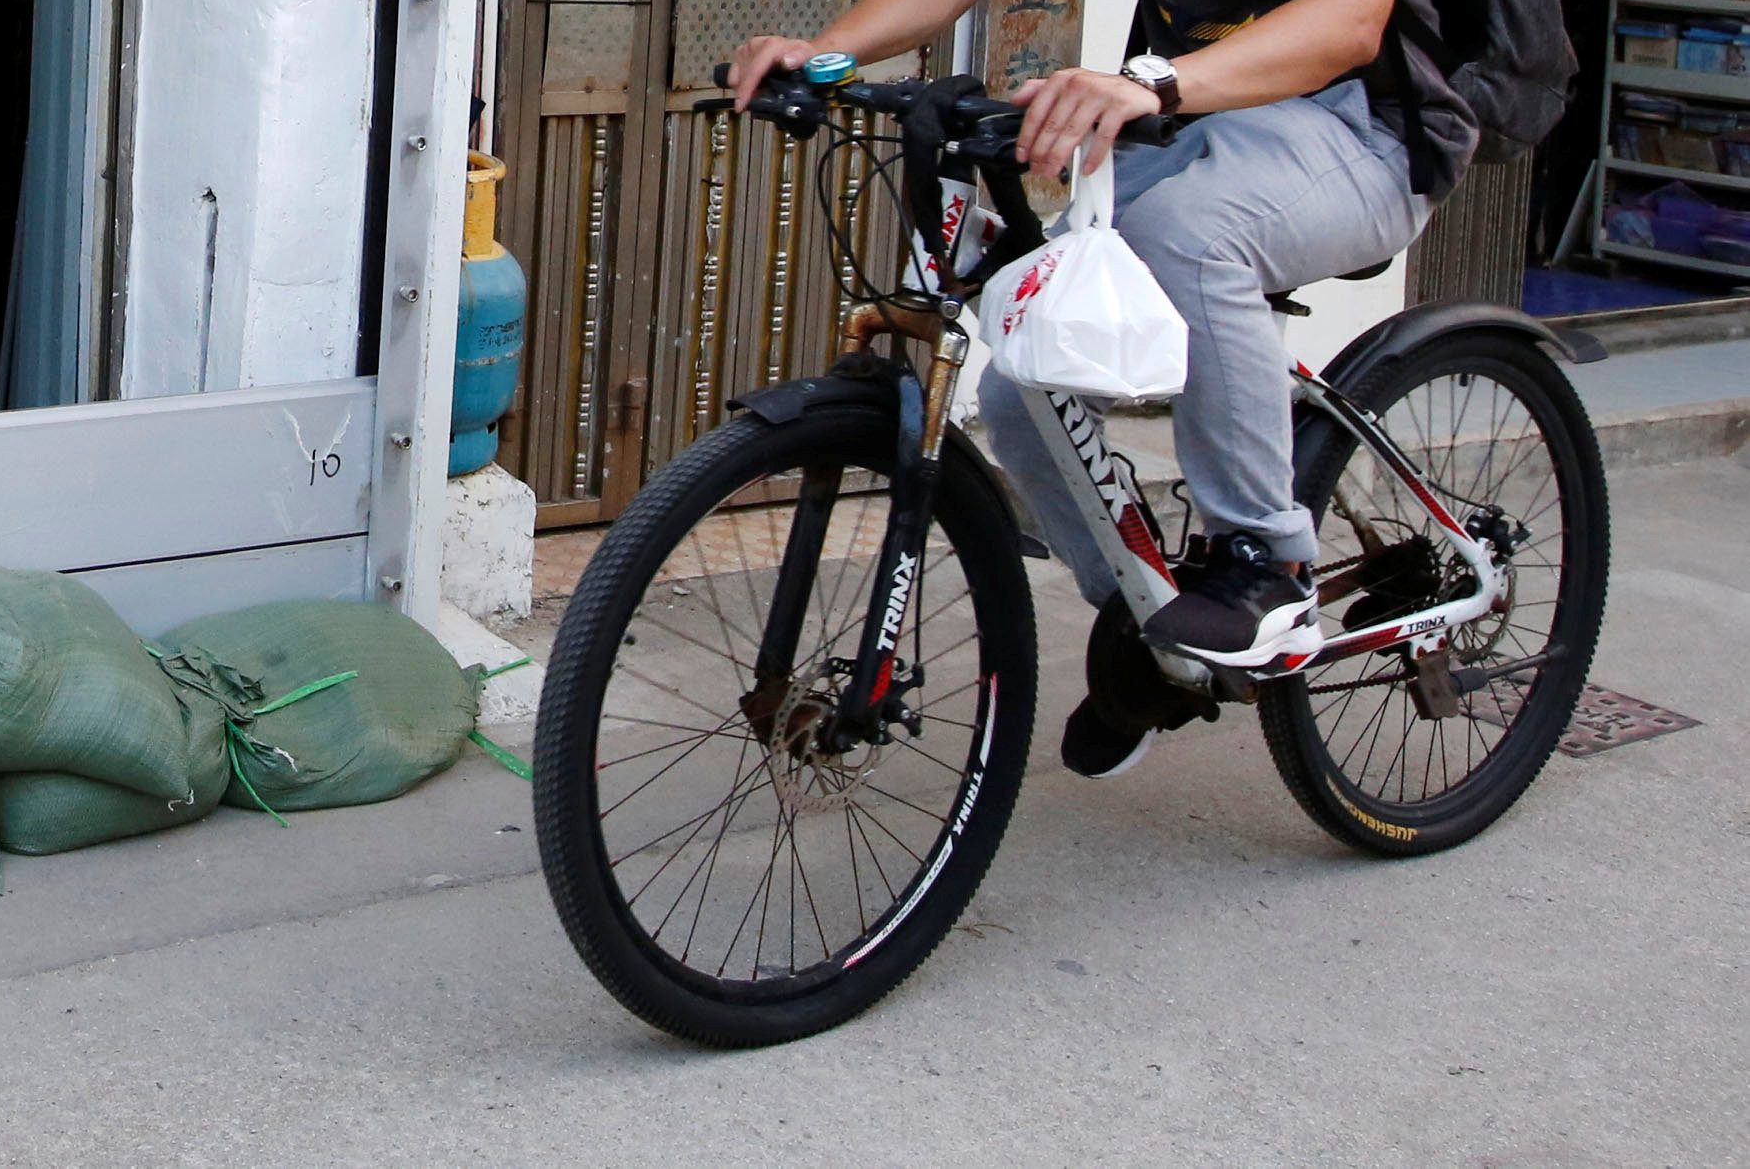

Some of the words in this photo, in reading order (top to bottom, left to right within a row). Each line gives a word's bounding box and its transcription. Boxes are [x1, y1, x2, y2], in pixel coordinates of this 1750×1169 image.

[309, 448, 341, 486] 10
[1049, 390, 1132, 524] RINX
[876, 550, 917, 652] TRINX
[1407, 615, 1447, 633] TRINX
[952, 772, 984, 836] TRINX
